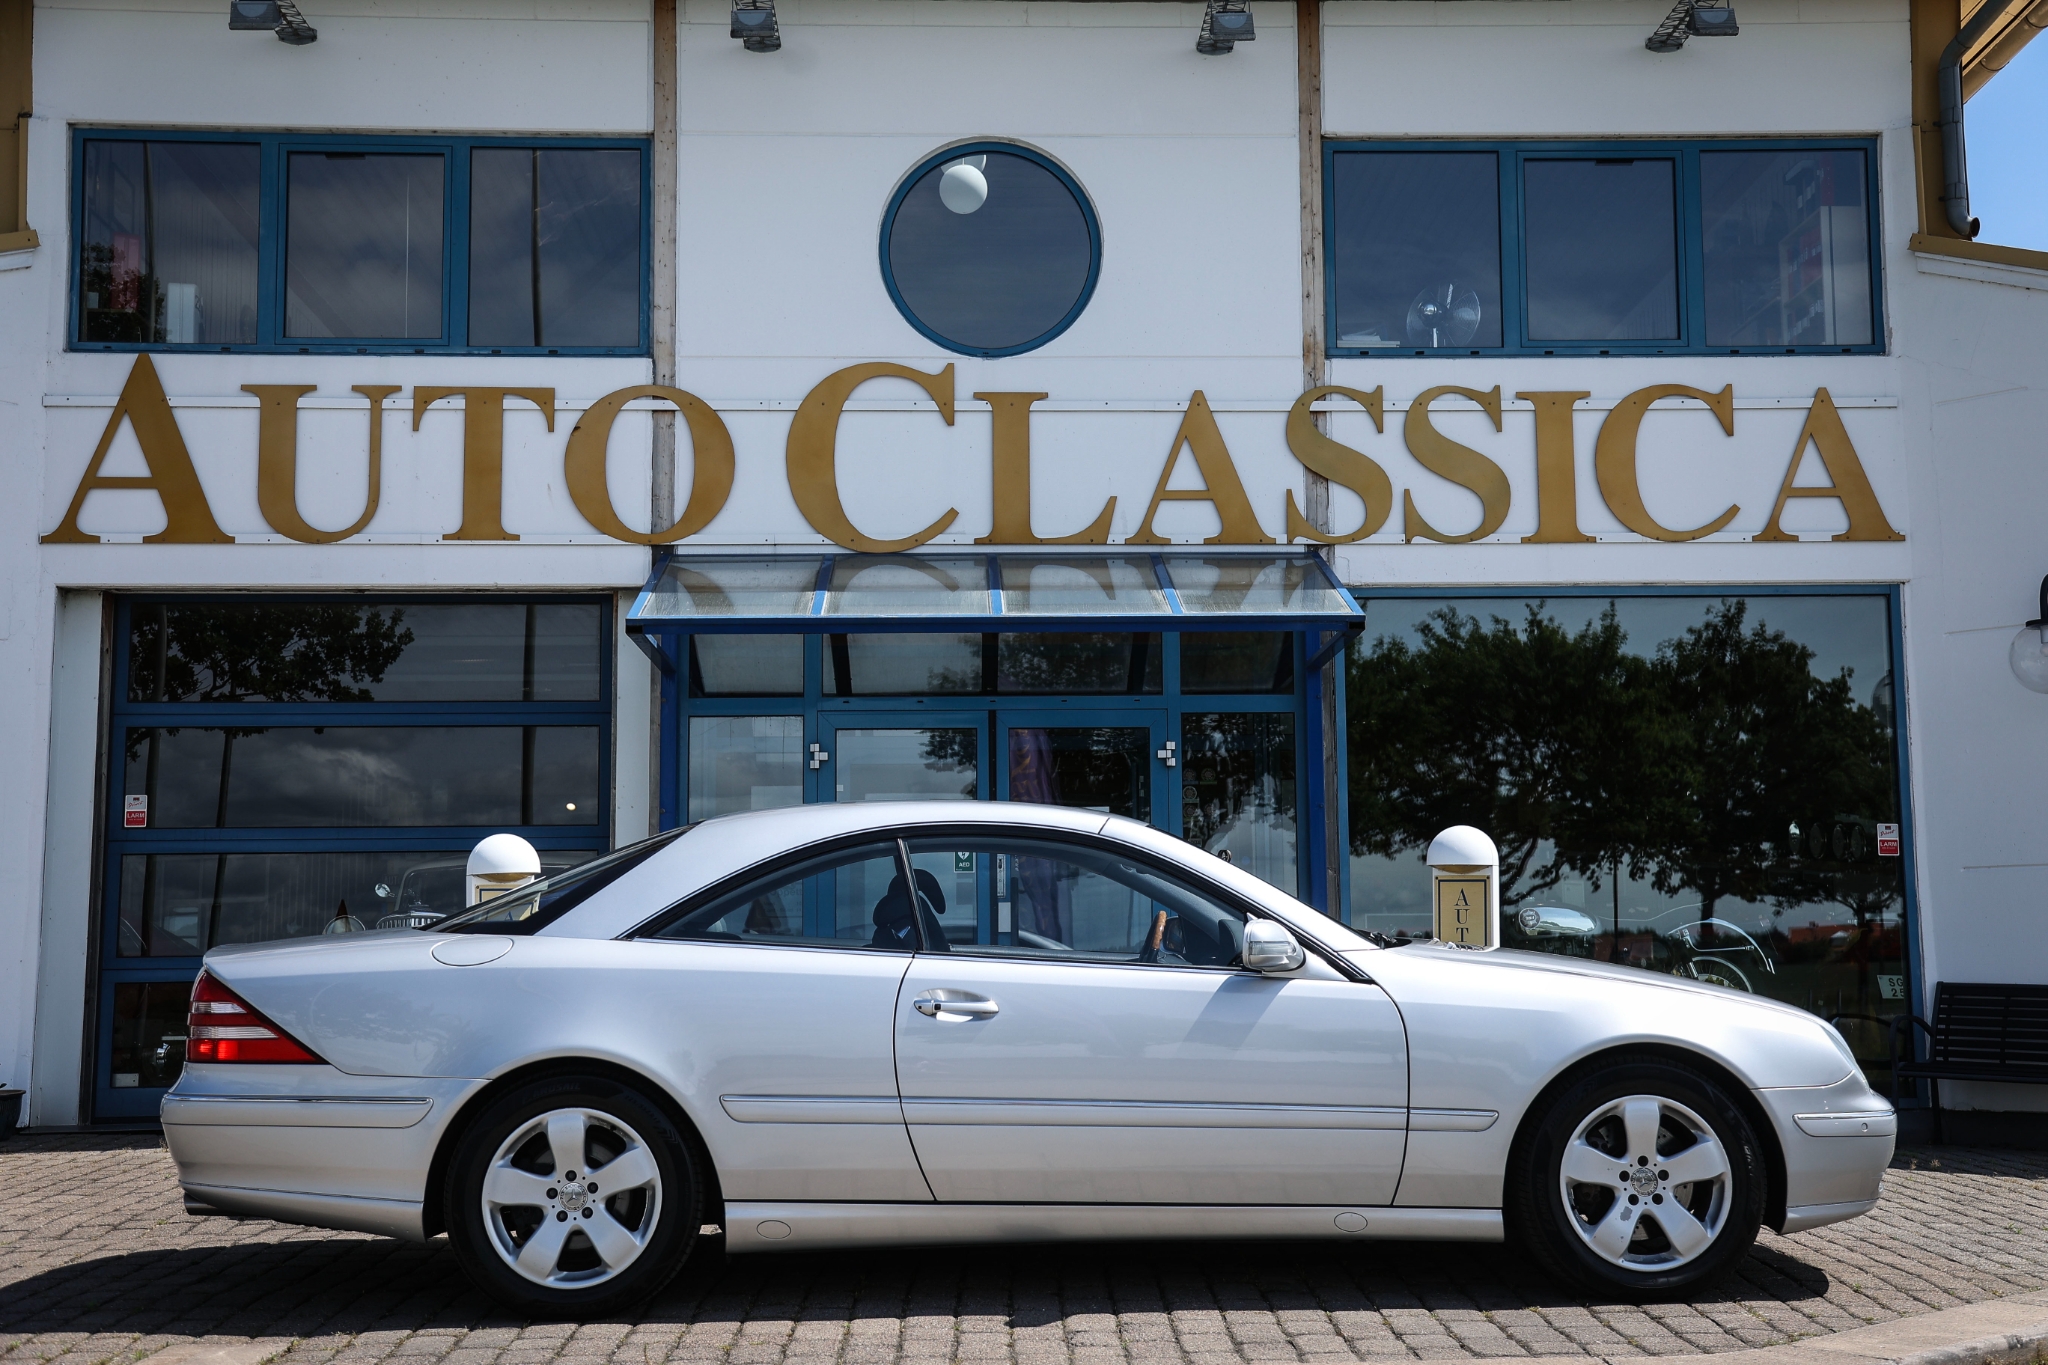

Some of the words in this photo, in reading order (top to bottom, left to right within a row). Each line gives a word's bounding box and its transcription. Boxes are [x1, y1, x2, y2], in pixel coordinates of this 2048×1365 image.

[41, 353, 735, 546] AUTO
[786, 361, 1906, 553] CLASSICA
[1453, 887, 1471, 943] AUT
